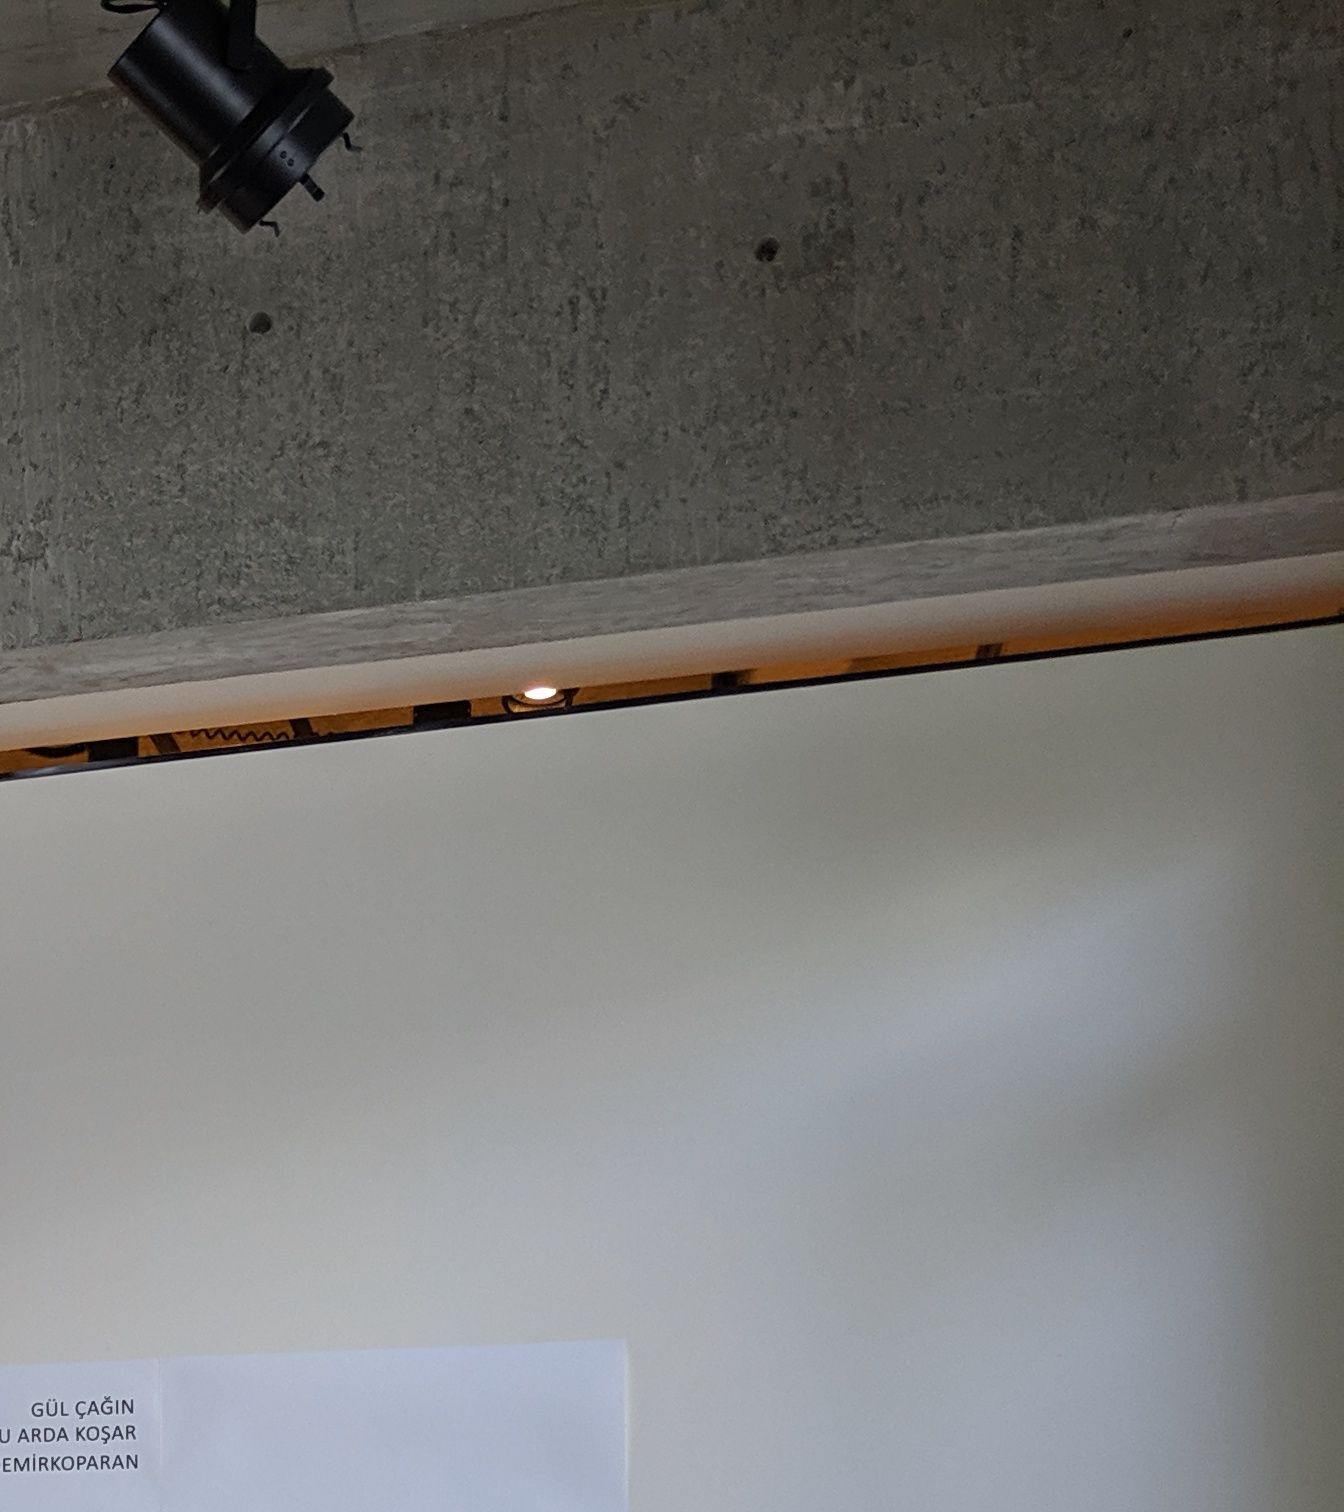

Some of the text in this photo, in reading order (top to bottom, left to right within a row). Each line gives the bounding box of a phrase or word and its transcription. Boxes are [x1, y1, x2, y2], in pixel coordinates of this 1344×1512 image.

[31, 1396, 134, 1419] GÜL ÇAĞIN
[17, 1427, 69, 1443] ARDA
[75, 1425, 136, 1444] KOŞAR
